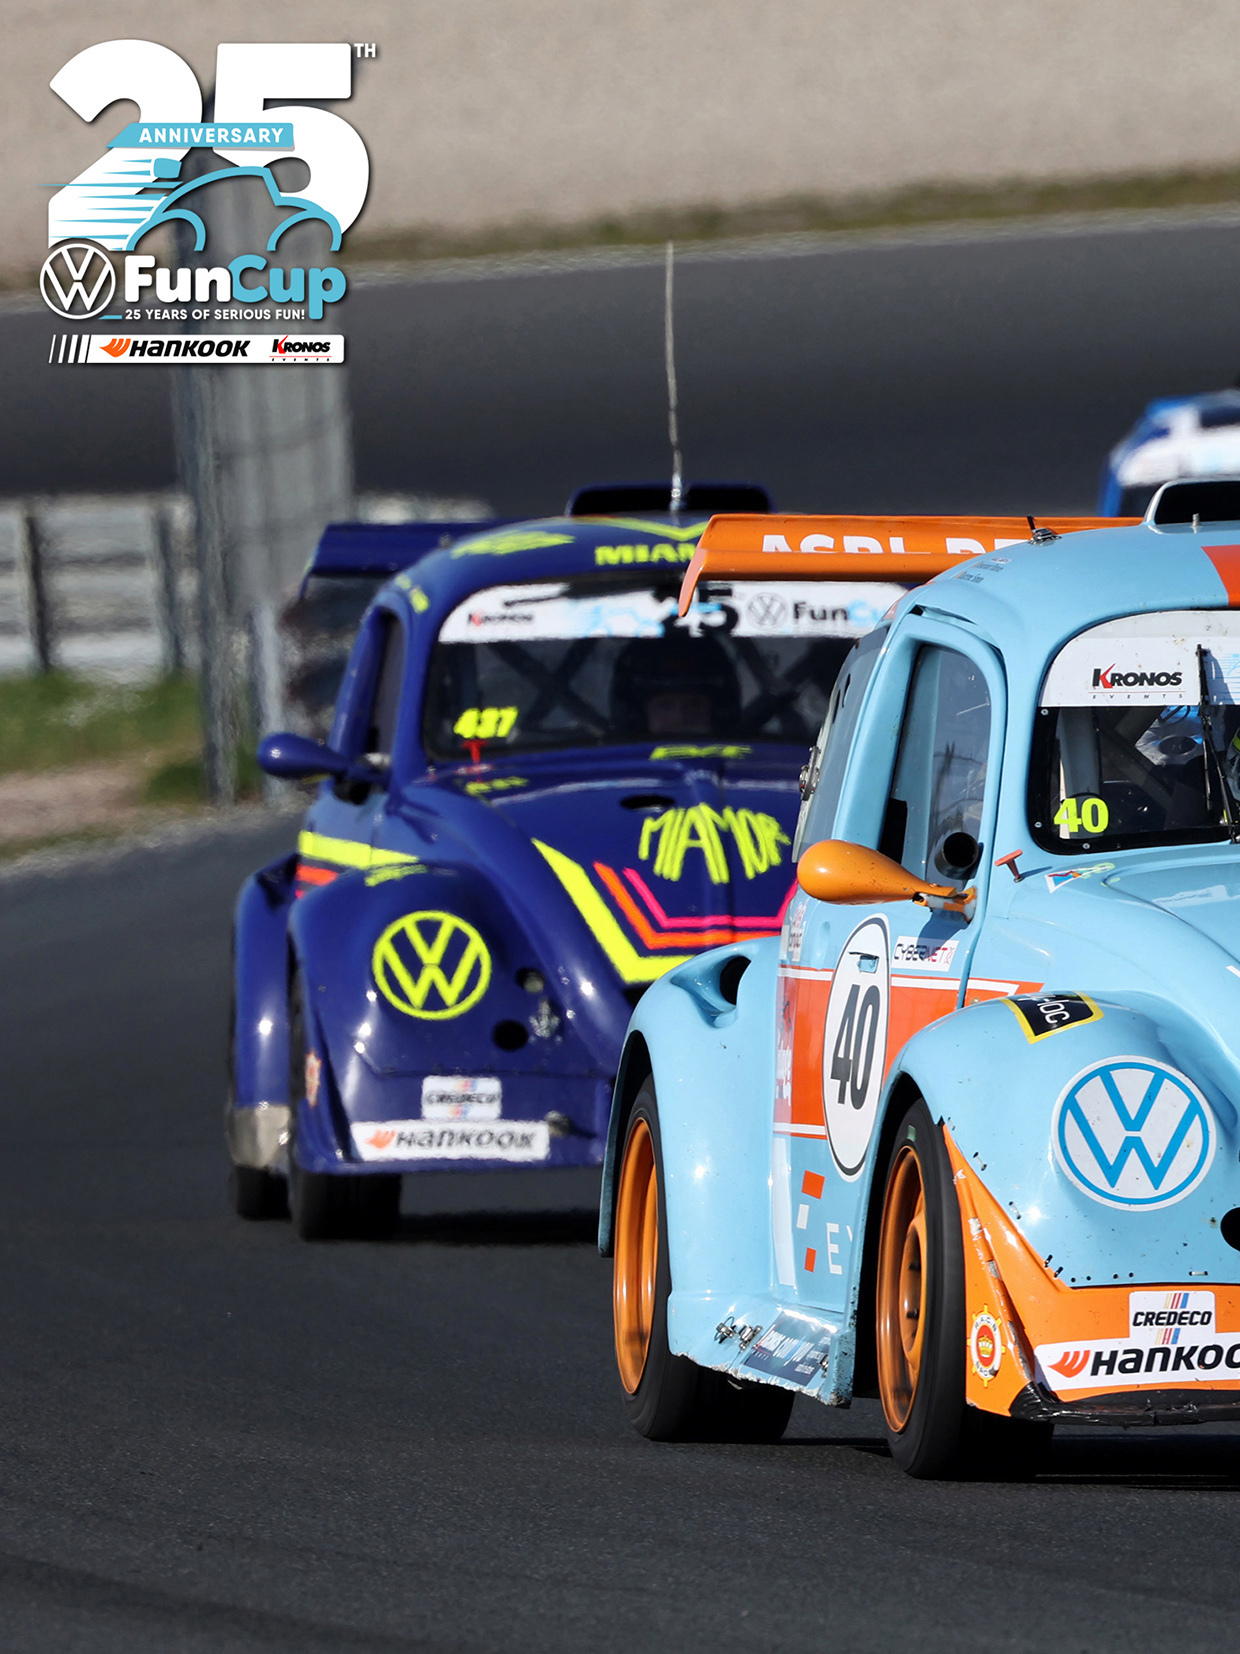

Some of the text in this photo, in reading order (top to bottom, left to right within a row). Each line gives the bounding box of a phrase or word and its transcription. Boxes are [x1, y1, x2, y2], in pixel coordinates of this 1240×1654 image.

[1092, 663, 1183, 689] KRONOS
[1053, 797, 1109, 833] 40
[894, 943, 948, 962] CYBERNET
[830, 983, 881, 1111] 40
[1132, 1310, 1213, 1327] CREDECO
